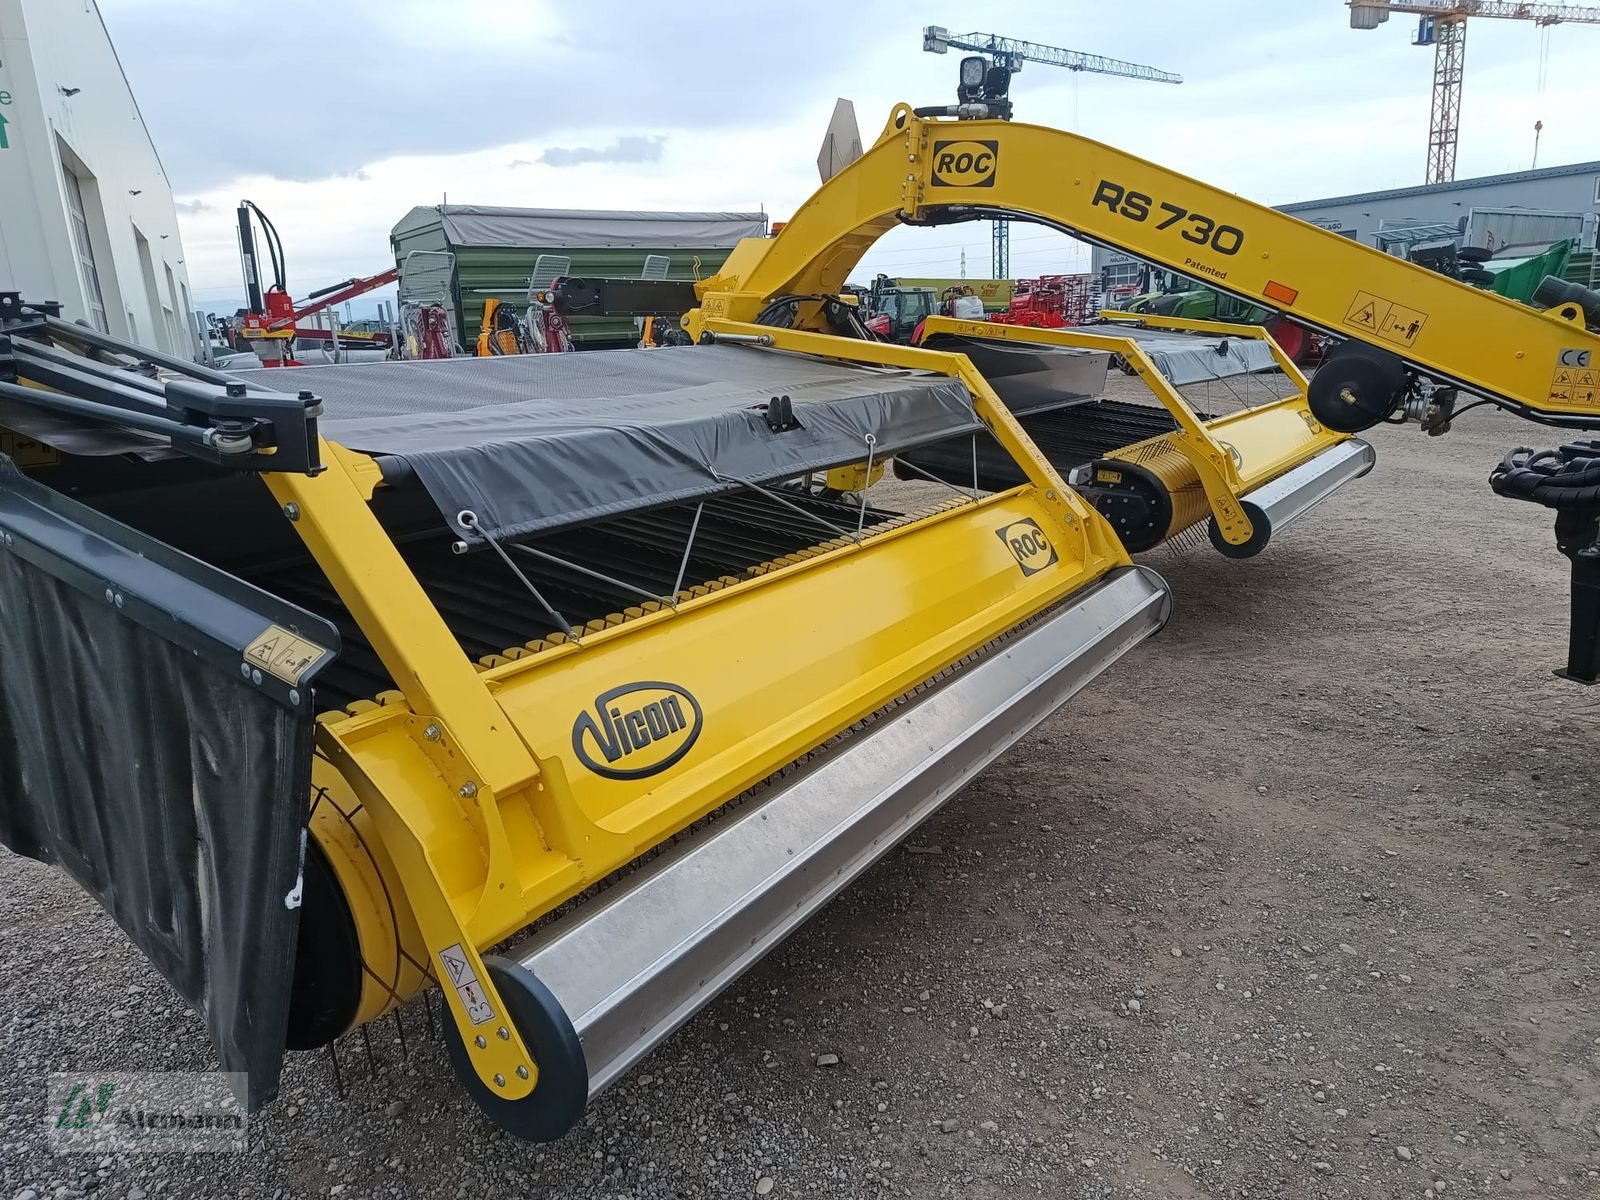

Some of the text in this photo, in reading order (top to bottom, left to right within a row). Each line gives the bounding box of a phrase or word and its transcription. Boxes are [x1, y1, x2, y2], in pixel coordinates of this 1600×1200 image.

[937, 152, 992, 173] ROC
[1092, 179, 1245, 255] RS 730
[1184, 257, 1228, 280] Patented
[1009, 528, 1047, 561] ROC
[575, 690, 690, 766] Vicon
